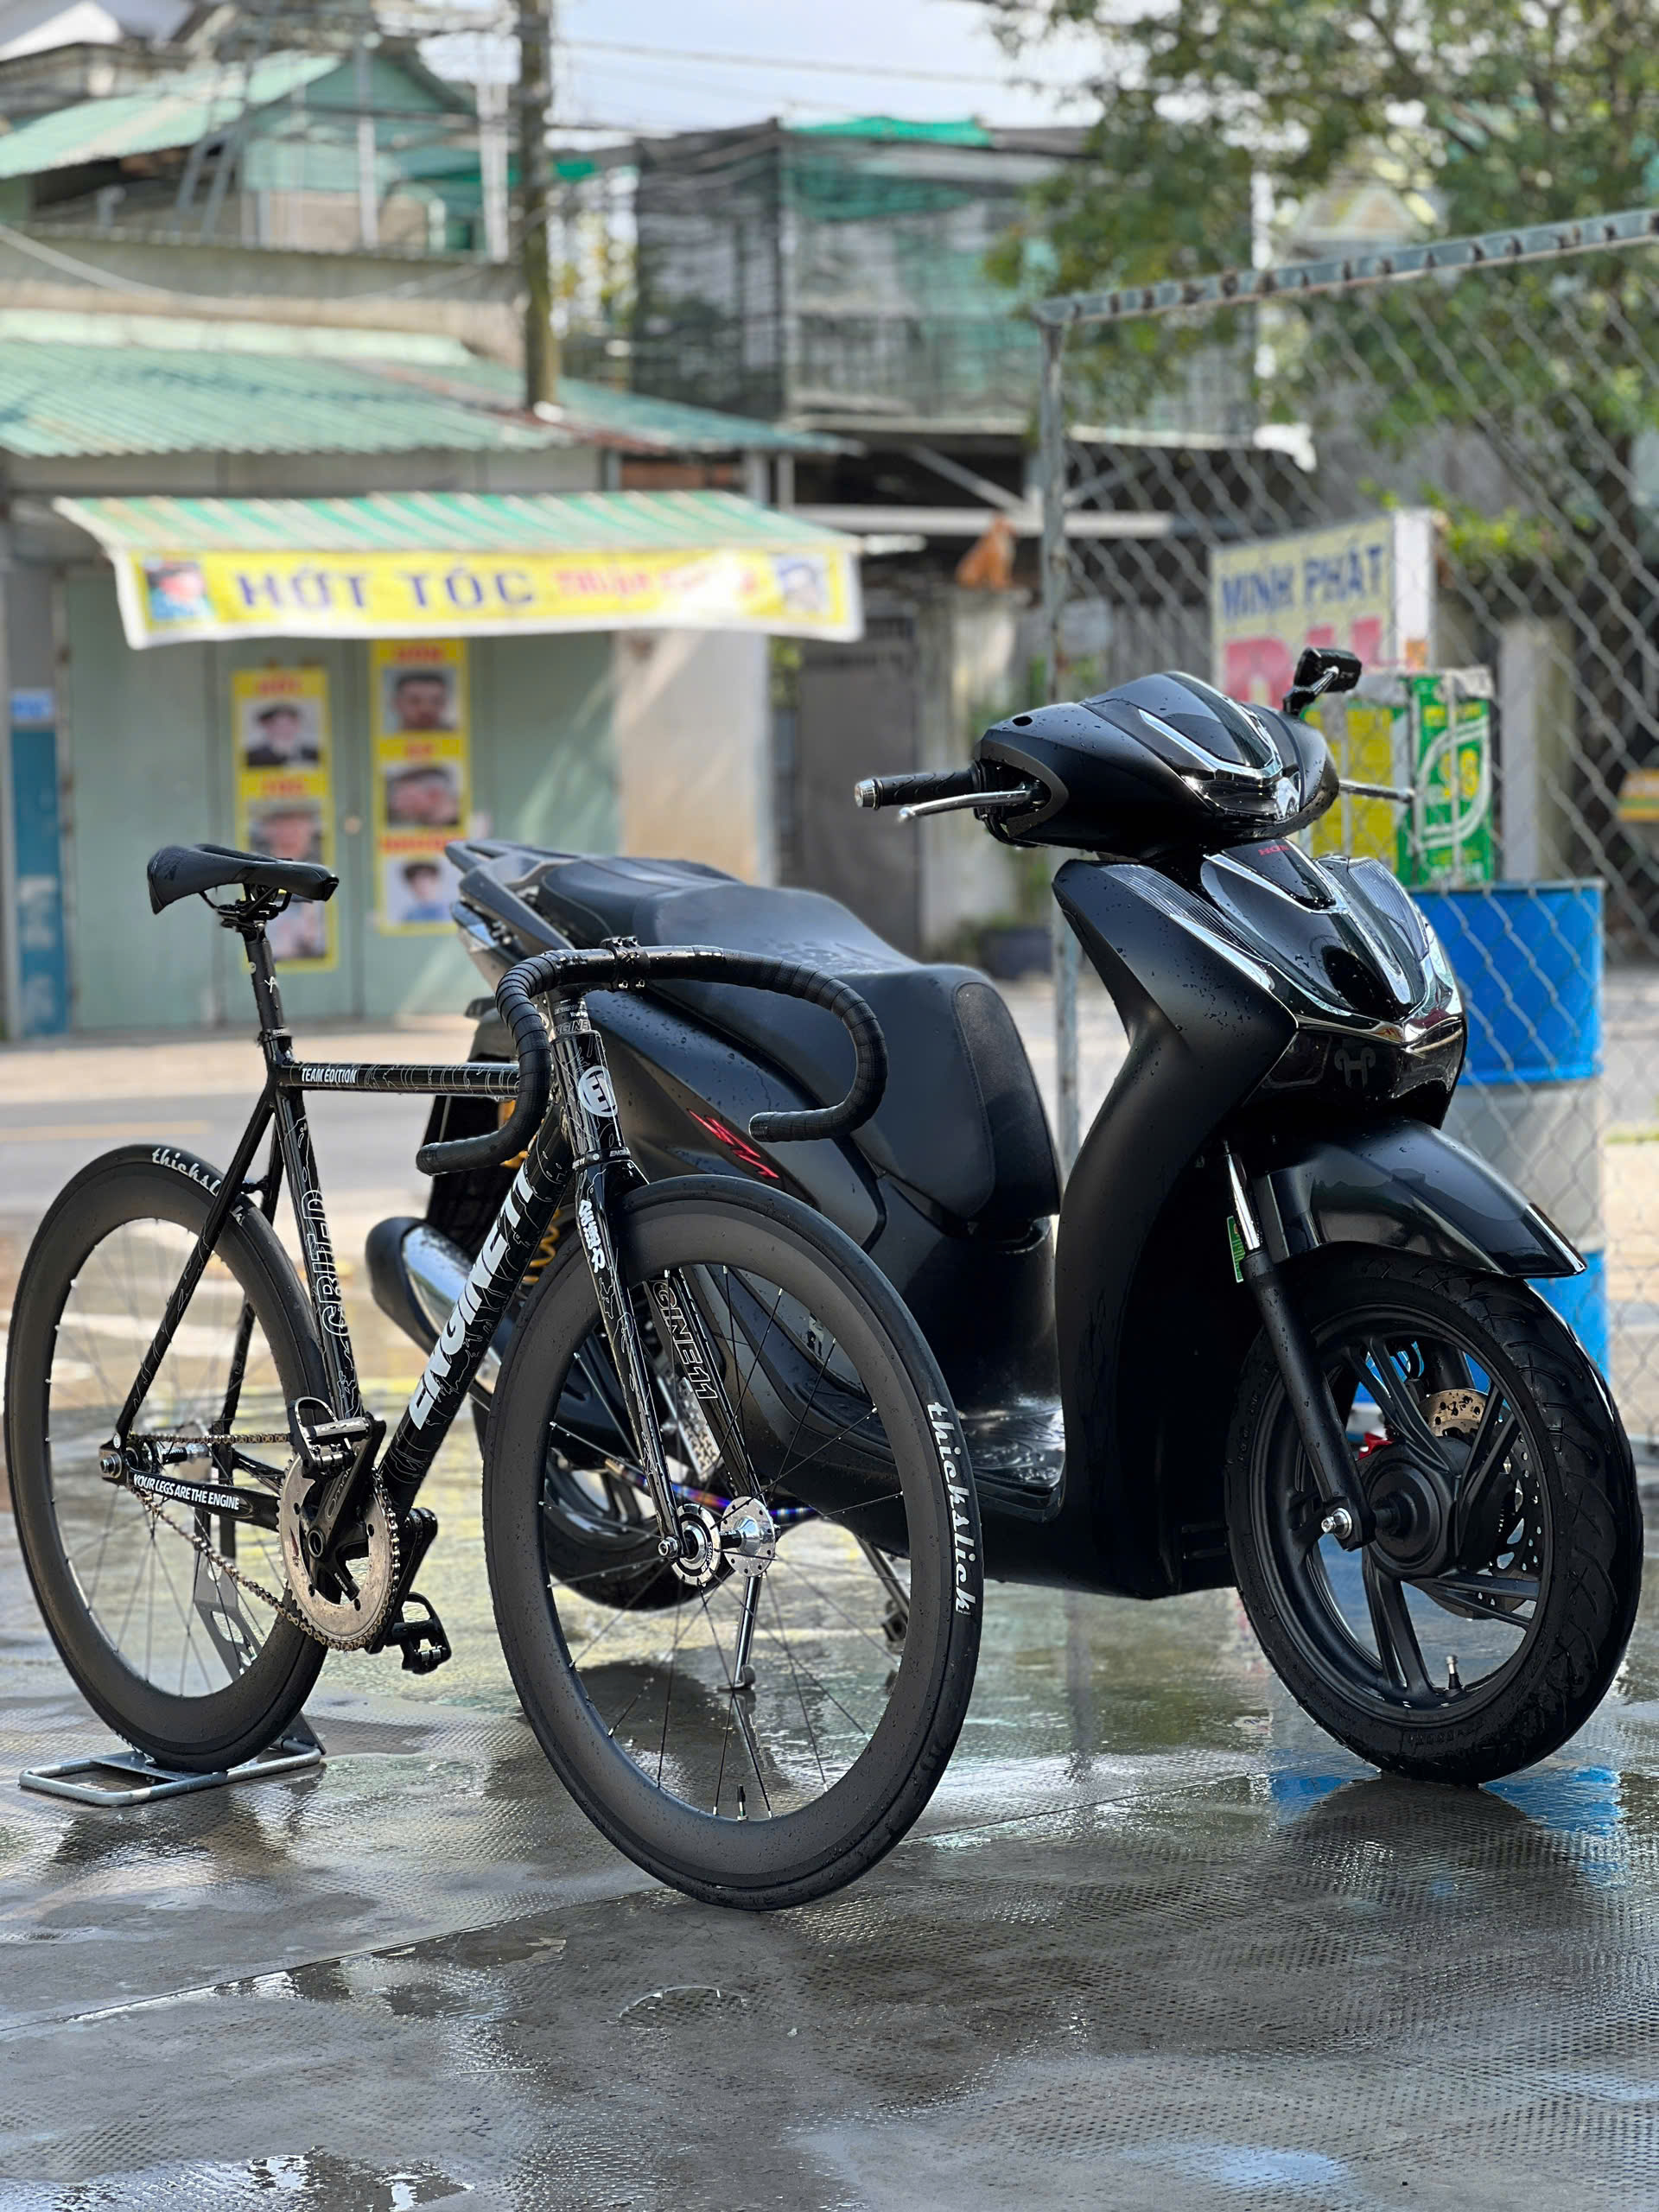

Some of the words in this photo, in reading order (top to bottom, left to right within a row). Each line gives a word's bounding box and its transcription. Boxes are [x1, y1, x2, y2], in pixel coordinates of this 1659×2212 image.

[237, 564, 366, 607] HỚT
[399, 563, 532, 607] TÓC
[1222, 567, 1294, 620] MINH
[302, 1068, 323, 1082] TEAM
[324, 1069, 357, 1083] EDITION
[152, 1147, 245, 1226] thickslk
[133, 1473, 156, 1491] YOUR
[156, 1478, 175, 1496] LEGS
[174, 1484, 191, 1500] ARE
[190, 1488, 207, 1504] THE
[207, 1493, 239, 1510] ENGINE
[927, 1402, 976, 1612] thickslick
